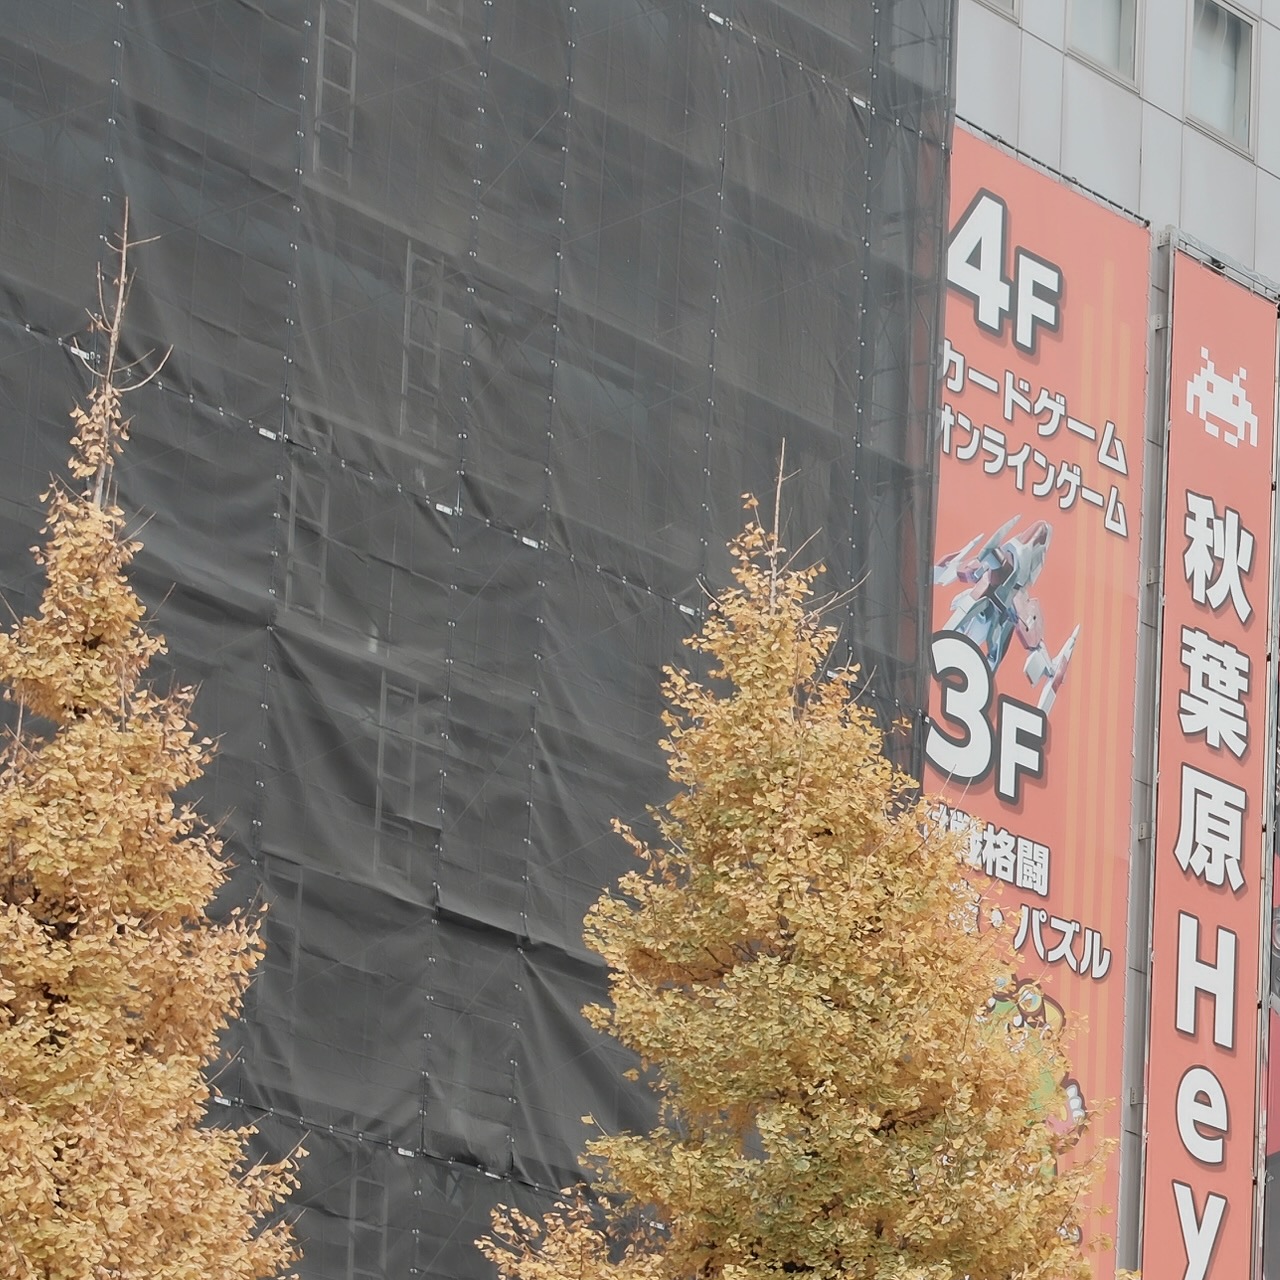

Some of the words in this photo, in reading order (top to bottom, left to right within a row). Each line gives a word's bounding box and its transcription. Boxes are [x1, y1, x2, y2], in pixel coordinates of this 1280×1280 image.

[946, 190, 1062, 350] 4F
[936, 405, 1129, 538] オンラインゲーム
[937, 342, 1128, 478] カードゲーム
[924, 630, 1049, 803] 3F
